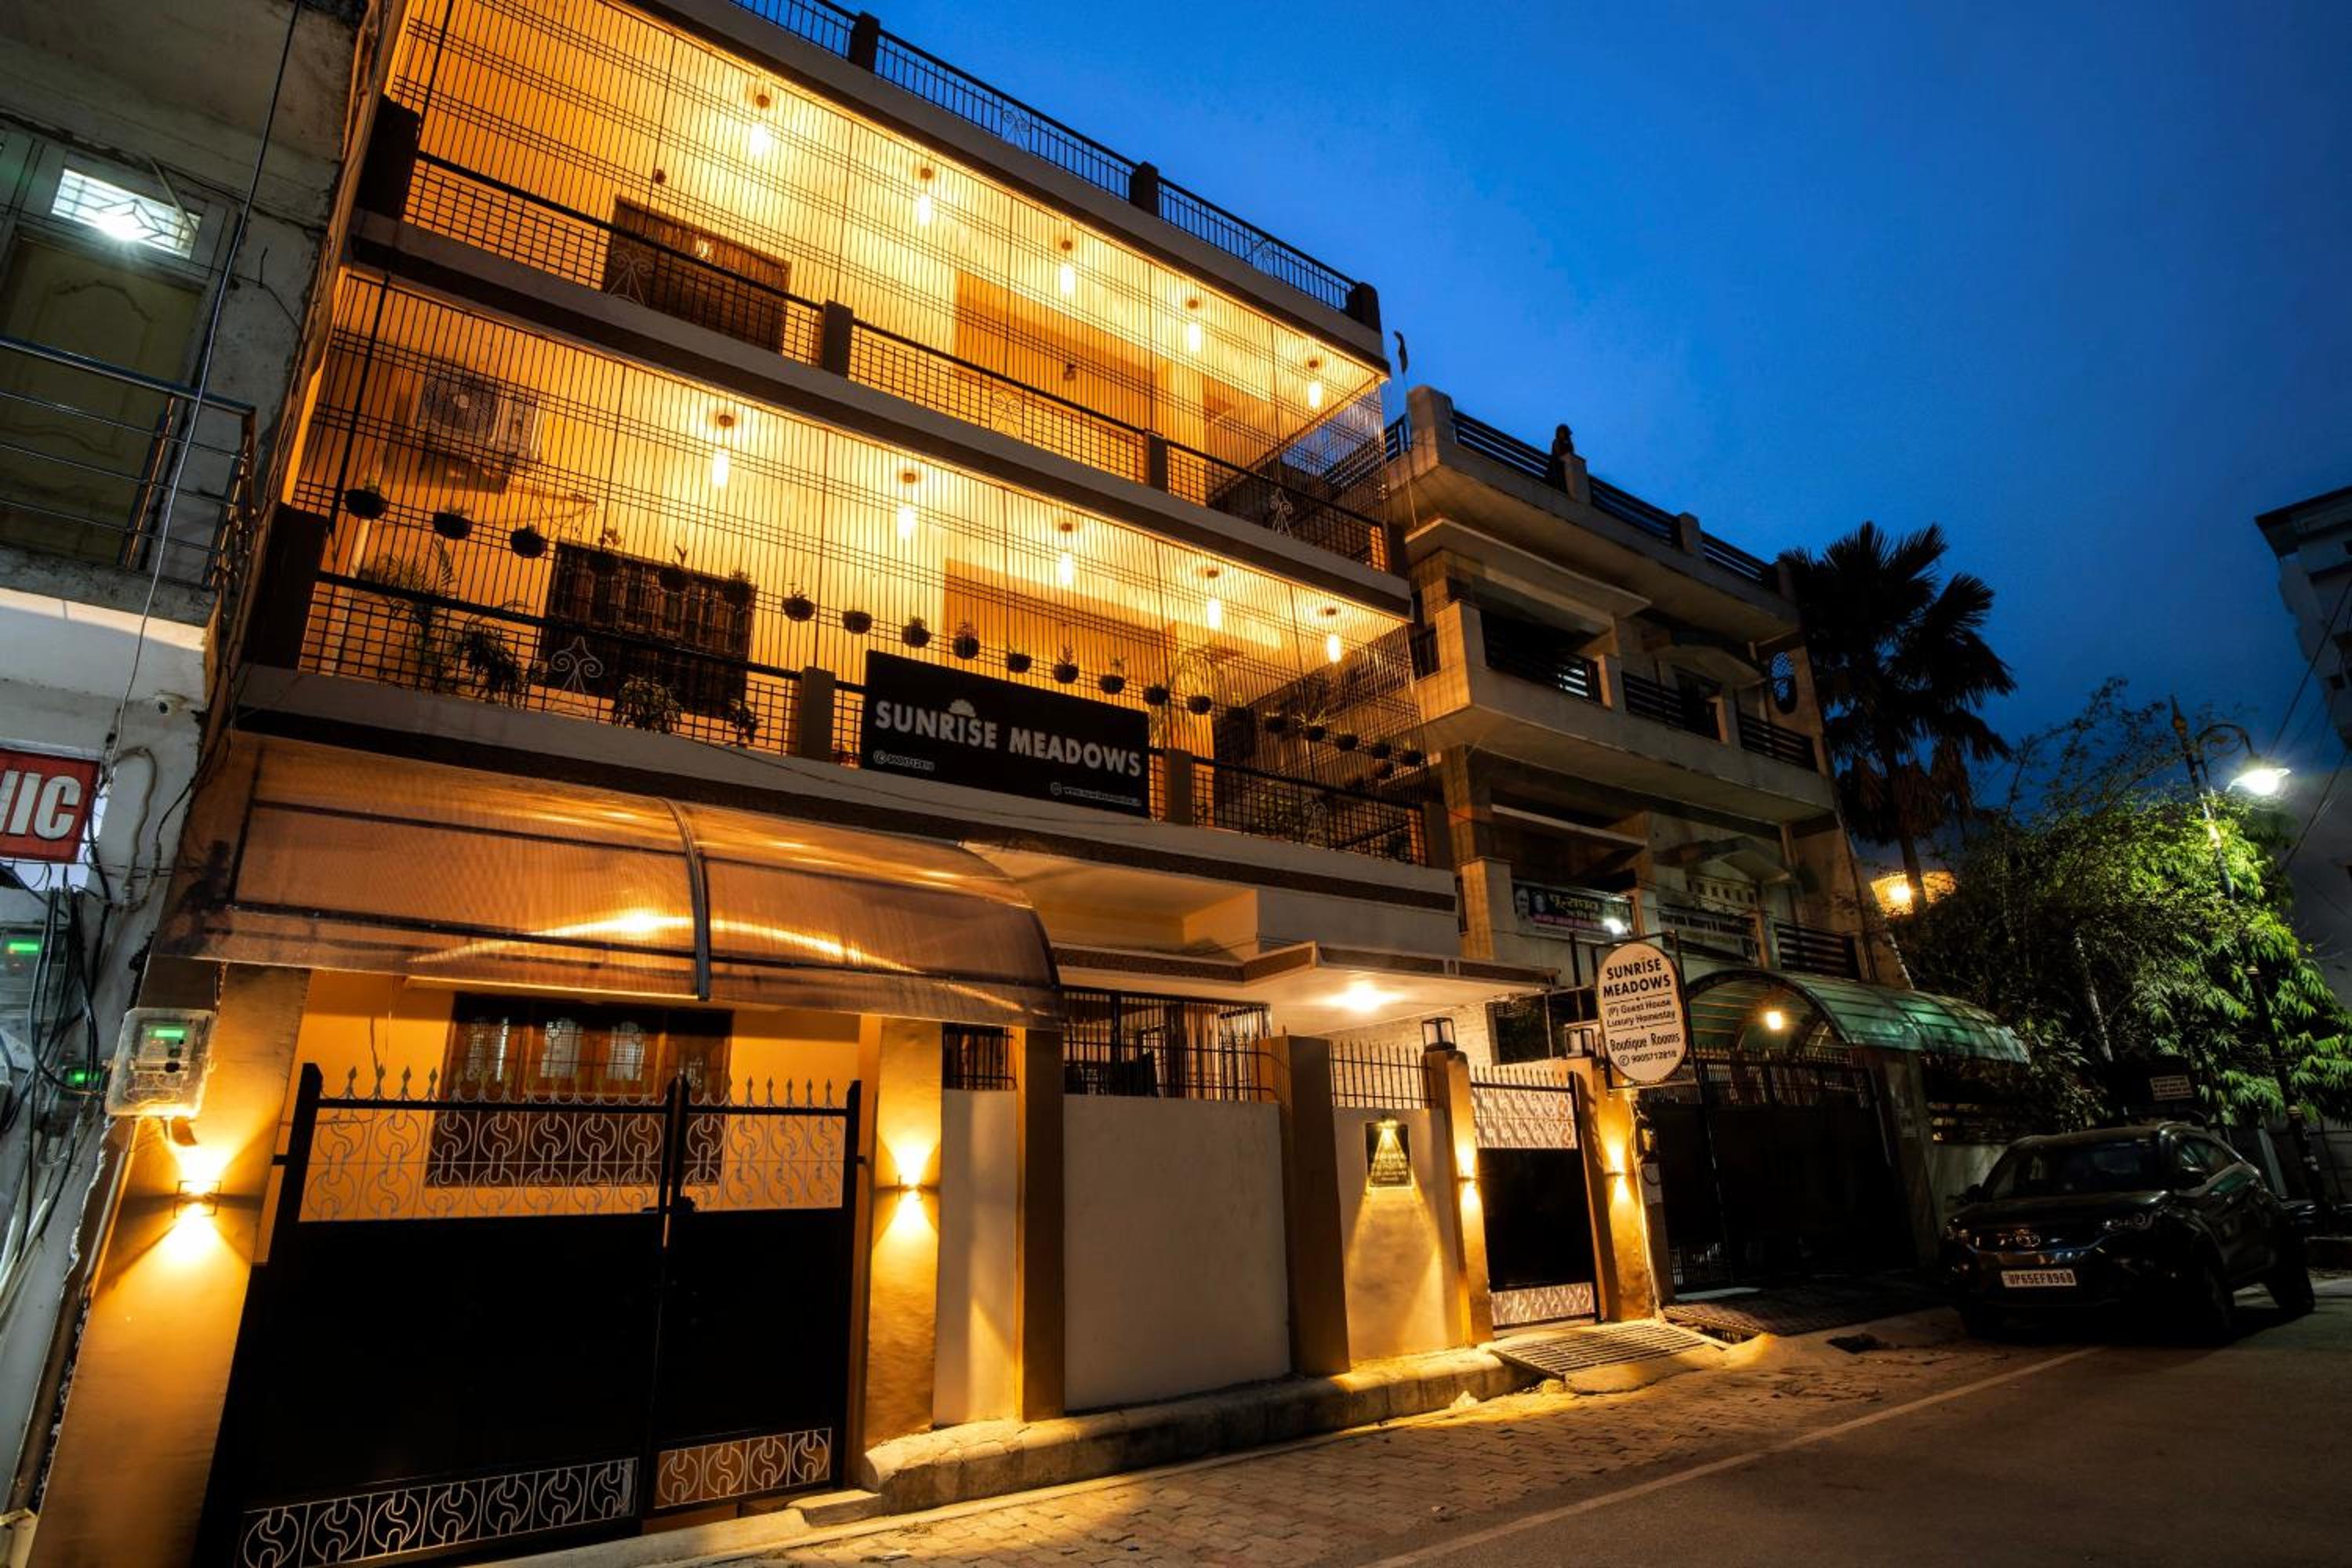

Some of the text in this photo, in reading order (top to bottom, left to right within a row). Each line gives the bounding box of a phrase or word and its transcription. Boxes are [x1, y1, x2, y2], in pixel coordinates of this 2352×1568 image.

[875, 700, 1142, 777] SUNRISE MEADOWS
[1607, 958, 1662, 981] SUNRISE
[1603, 974, 1671, 999] MEADOWS
[1621, 1003, 1645, 1014] Guest
[1646, 999, 1671, 1010] House
[1606, 1010, 1675, 1029] Luxury Homestay
[1610, 1033, 1680, 1053] Boutique Rooms
